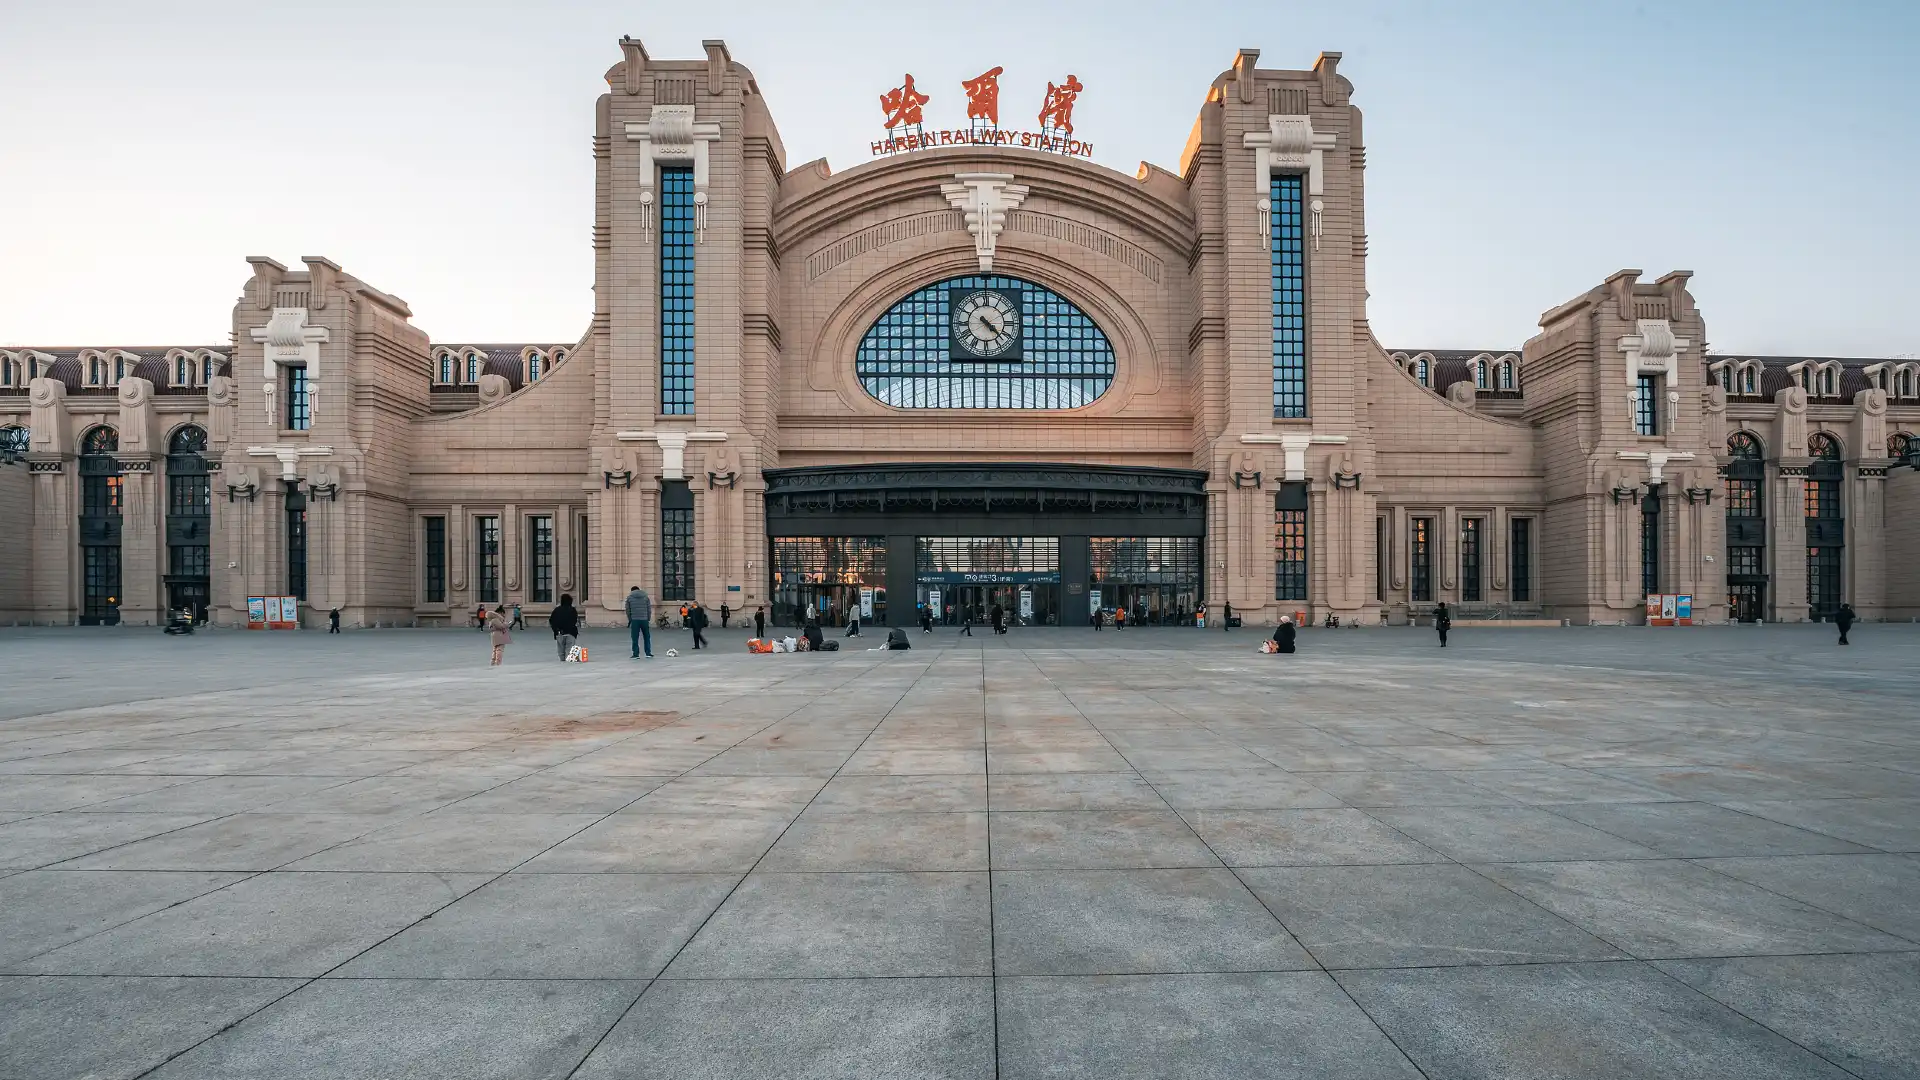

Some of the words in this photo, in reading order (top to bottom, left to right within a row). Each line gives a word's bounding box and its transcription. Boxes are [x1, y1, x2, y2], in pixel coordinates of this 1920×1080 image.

[871, 131, 937, 156] HARBIN
[940, 129, 1018, 145] RAILWAY
[1021, 132, 1093, 157] STATION
